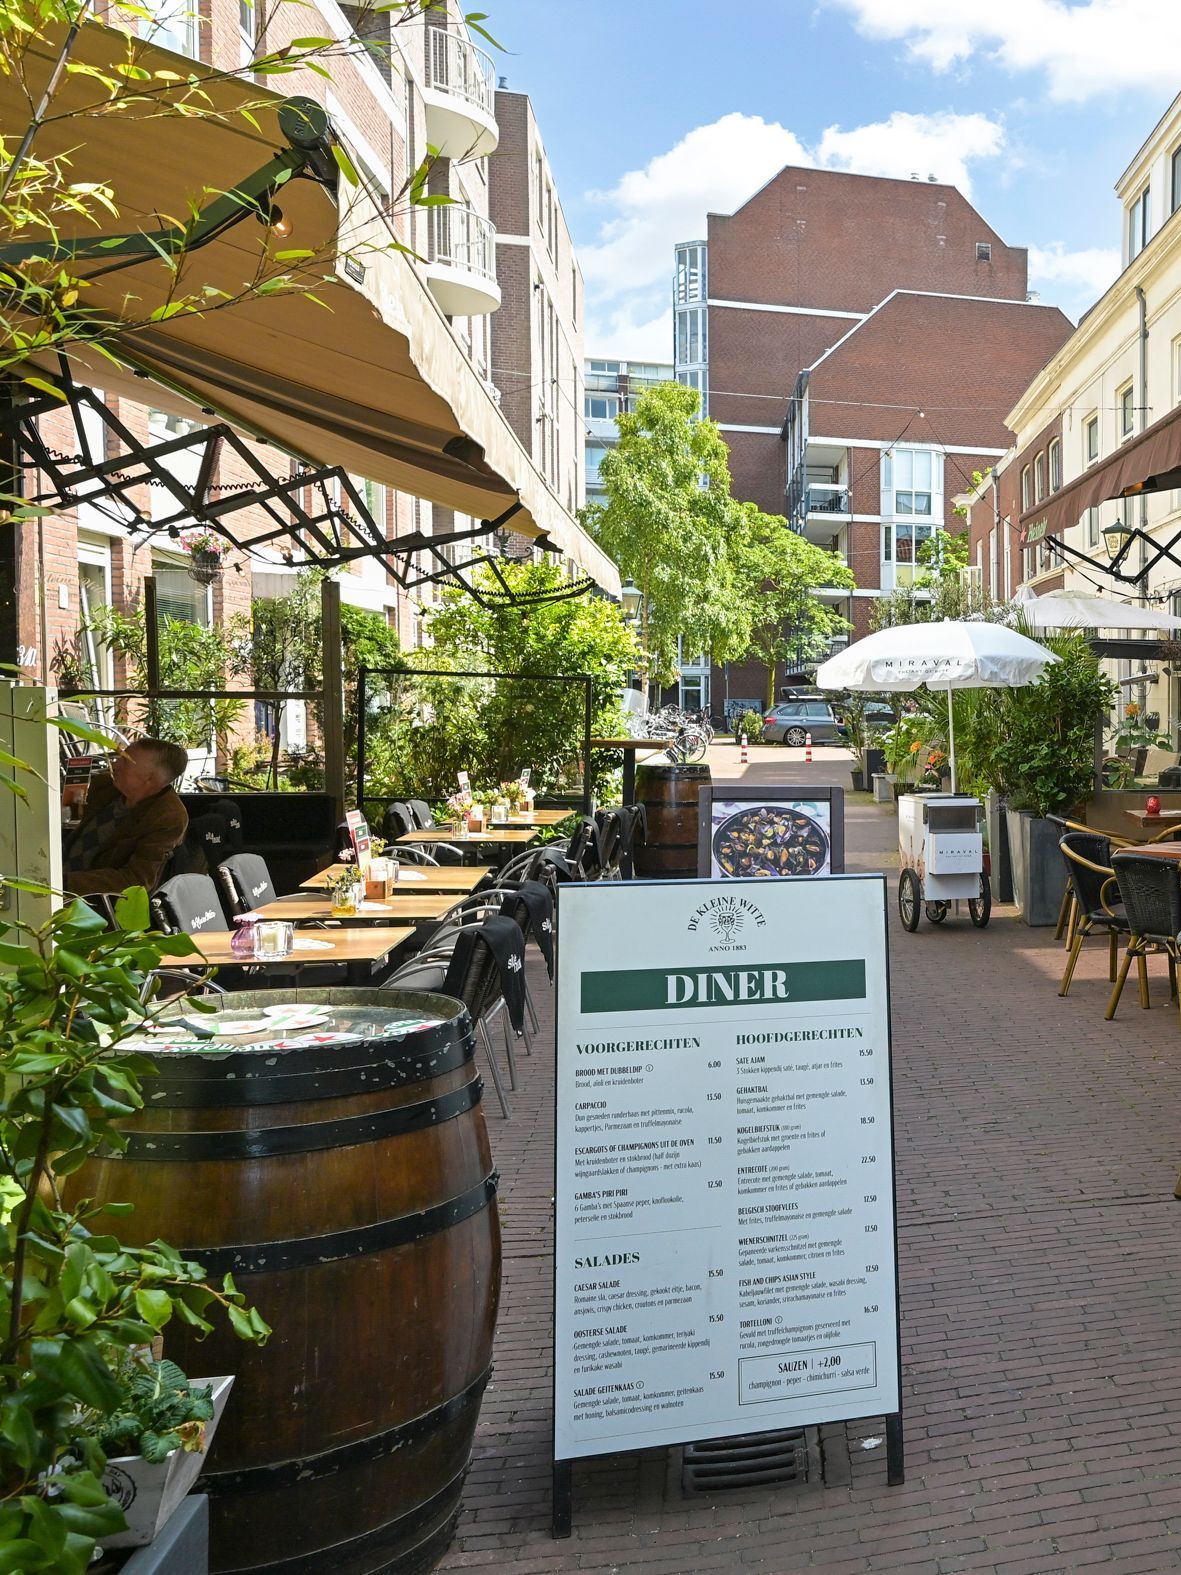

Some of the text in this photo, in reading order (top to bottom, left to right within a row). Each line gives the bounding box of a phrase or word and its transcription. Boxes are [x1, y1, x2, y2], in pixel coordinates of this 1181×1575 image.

[885, 659, 962, 668] MIRAVAL
[688, 897, 766, 931] DE KLEINE WITTE
[665, 970, 789, 1004] DINER
[736, 1028, 862, 1044] HOOFDGERECHTEN
[576, 1037, 699, 1054] VOORGERECHTEN
[575, 1068, 596, 1077] BROOD
[610, 1065, 642, 1074] DUBBELDIP
[736, 1085, 768, 1094] GEHAKTBAL
[707, 1092, 721, 1100] 13.50
[574, 1100, 606, 1110] CARPACCIO
[860, 1116, 874, 1124] 18.50
[737, 1124, 780, 1134] KOGELBIEFSTUK
[708, 1136, 722, 1144] 11.50
[575, 1145, 608, 1155] ESCARGOTS
[617, 1141, 659, 1151] CHAMPIGNONS
[660, 1140, 669, 1148] UIT
[861, 1155, 876, 1163] 22.50
[737, 1164, 767, 1174] ENTRECOTE
[707, 1180, 722, 1188] 12.50
[602, 1189, 614, 1198] PIRI
[615, 1188, 627, 1196] PIRI
[738, 1202, 798, 1215] BELGISCH STOOFVLEES
[738, 1234, 787, 1245] WIENERSCHNITZEL
[574, 1252, 639, 1268] SALADES
[708, 1269, 723, 1277] 15.50
[865, 1264, 878, 1272] 17.50
[738, 1278, 751, 1287] FISH
[764, 1275, 781, 1284] CHIPS
[782, 1273, 798, 1282] ASIAN
[799, 1271, 816, 1280] STYLE
[574, 1280, 620, 1292] CAESAR SALADE
[864, 1304, 878, 1313] 16.50
[708, 1313, 724, 1322] 15.50
[740, 1318, 772, 1328] TORTELLONI
[573, 1325, 627, 1338] OOSTERSE SALADE
[778, 1355, 840, 1373] SAUZEN +2,00
[709, 1370, 724, 1379] 15.50
[748, 1366, 870, 1390] champignon peper chimichurri salsa verde
[574, 1382, 634, 1397] SALADE GEITENKAAS
